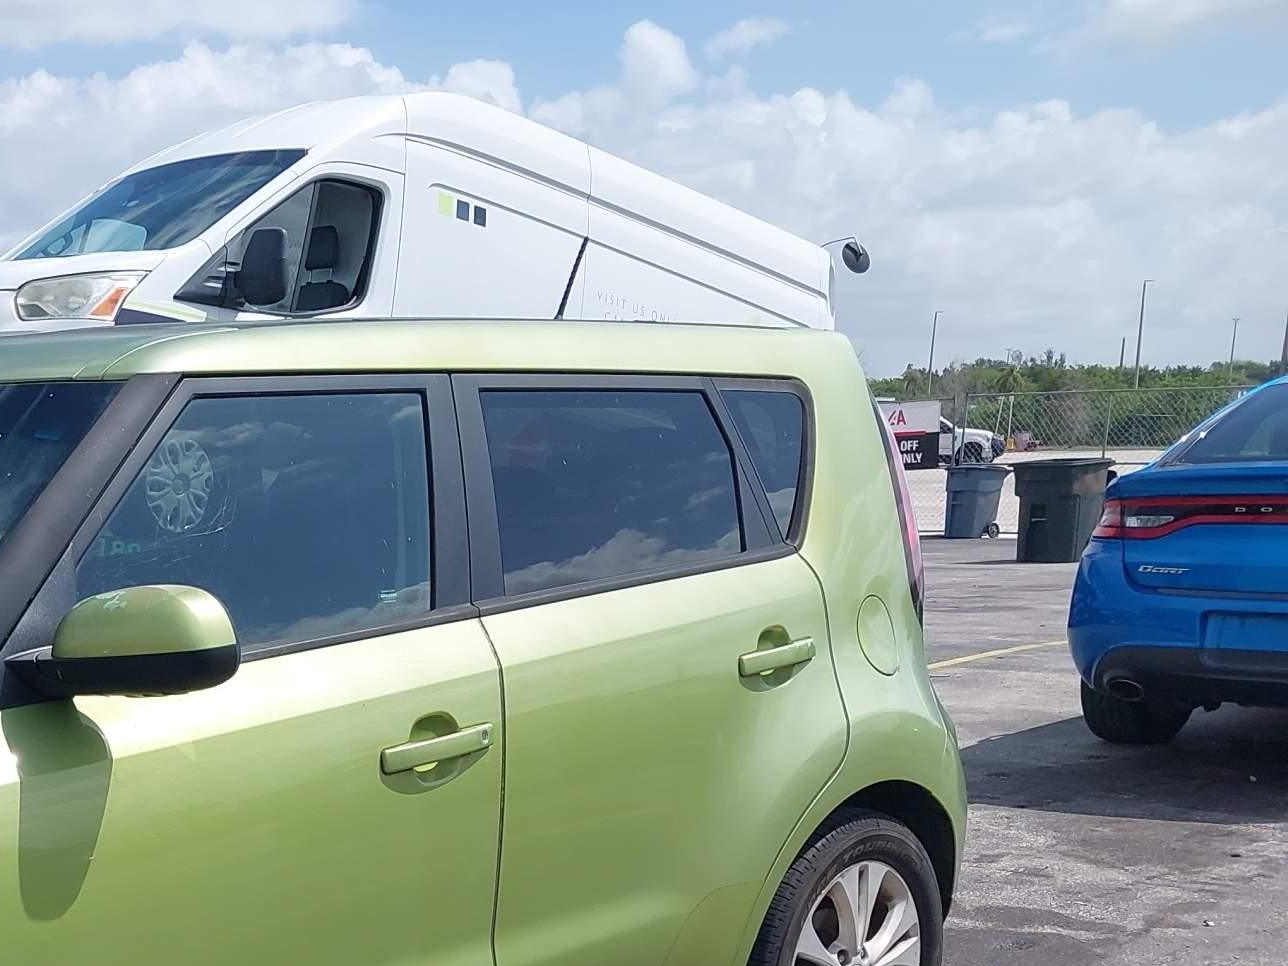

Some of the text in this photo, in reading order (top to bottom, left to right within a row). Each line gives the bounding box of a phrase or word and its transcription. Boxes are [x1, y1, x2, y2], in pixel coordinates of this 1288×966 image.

[597, 290, 626, 309] VISIT
[633, 303, 645, 317] US
[900, 440, 919, 451] OFF
[902, 452, 923, 464] NLY
